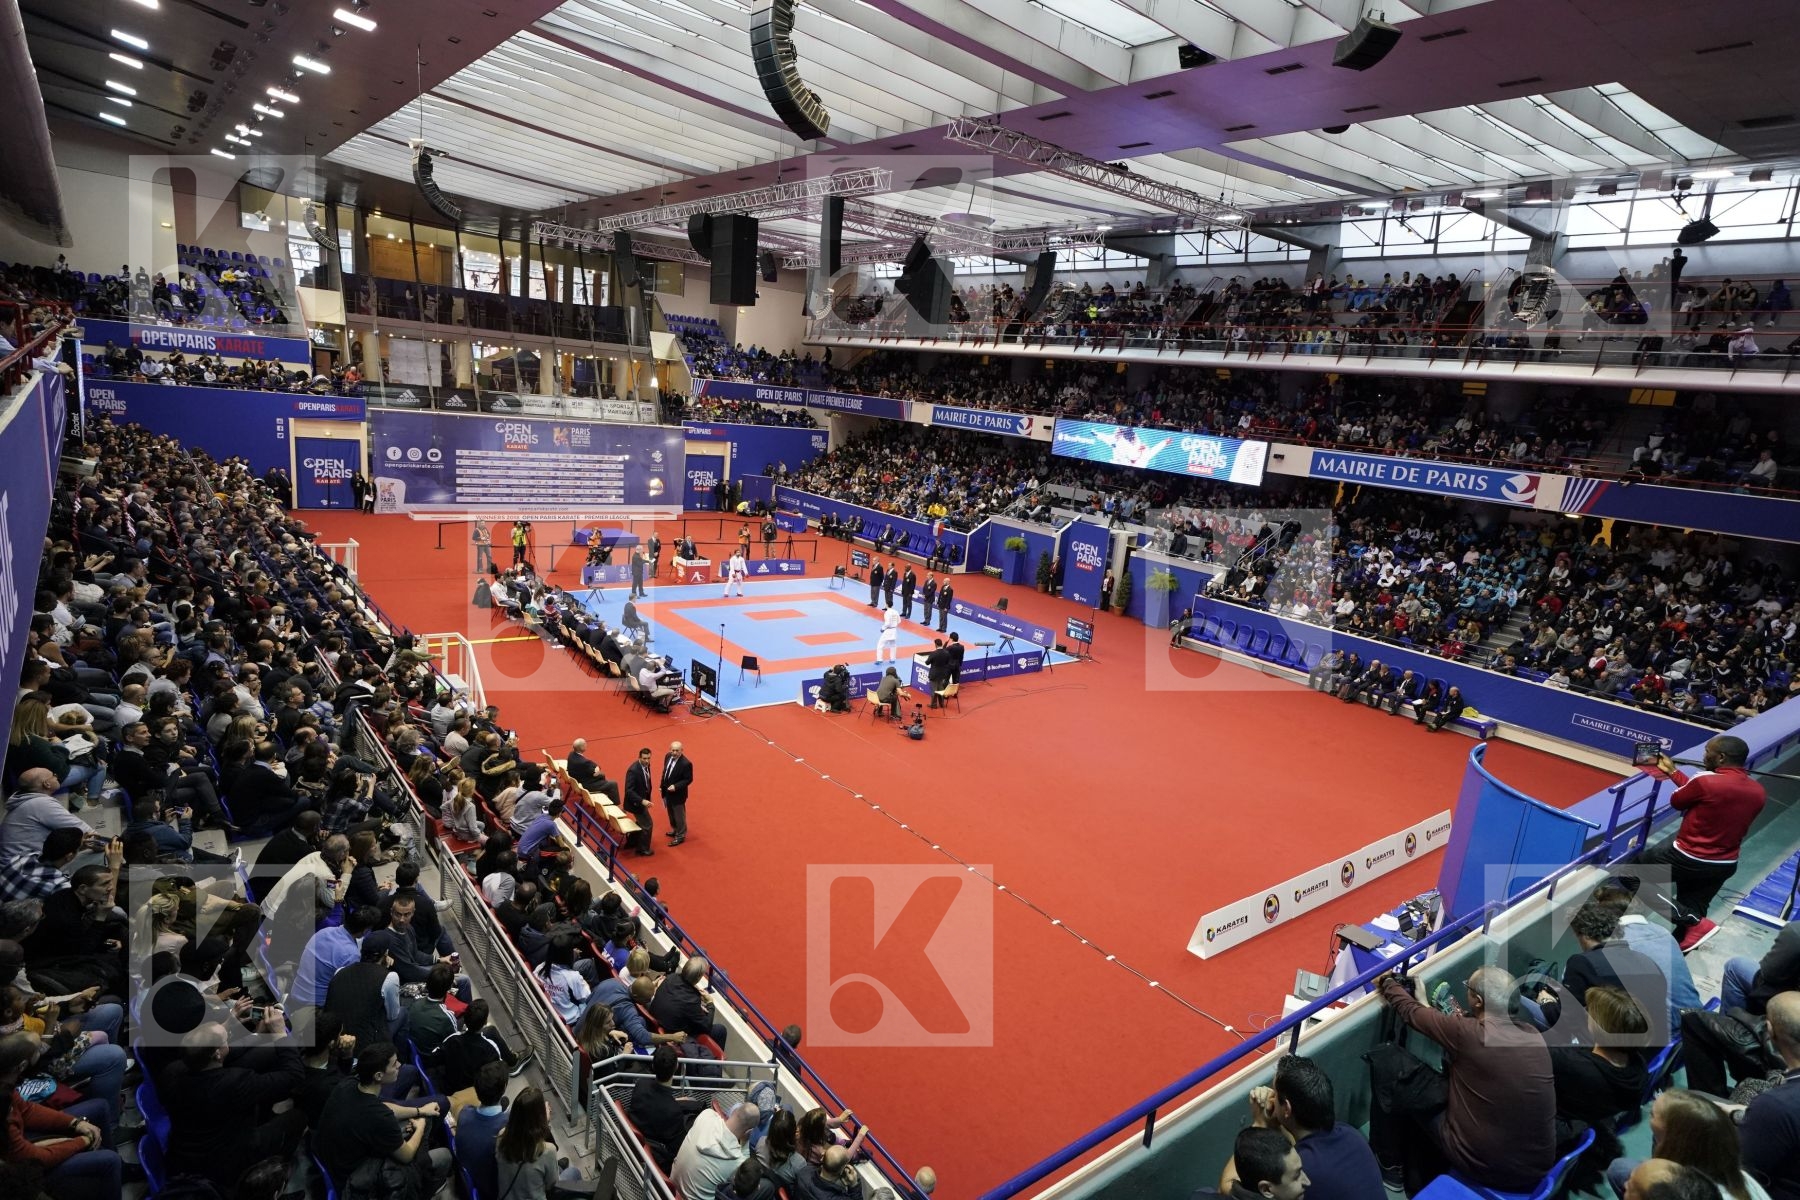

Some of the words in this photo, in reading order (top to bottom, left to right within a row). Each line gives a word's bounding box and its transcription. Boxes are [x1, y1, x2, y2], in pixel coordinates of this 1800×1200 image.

[90, 388, 114, 400] OPEN
[756, 388, 773, 400] OPEN
[774, 390, 783, 400] DE
[784, 391, 802, 402] PARIS
[99, 399, 127, 410] PARIS
[445, 400, 467, 408] adidas
[809, 393, 825, 405] KARATE
[826, 395, 845, 407] PREMIER
[845, 398, 863, 410] LEAGUE
[935, 410, 967, 424] MAIRIE
[969, 414, 980, 426] DE
[984, 416, 1012, 430] PARIS
[495, 422, 531, 434] OPEN
[571, 427, 591, 436] PARIS
[504, 433, 539, 444] PARIS
[1181, 437, 1221, 455] OPEN
[303, 457, 344, 469] OPEN
[1188, 450, 1228, 469] PARIS
[314, 468, 353, 478] PARIS
[687, 470, 713, 480] OPEN
[1317, 456, 1387, 479] MAIRIE
[1391, 465, 1420, 483] DE
[1425, 469, 1489, 491] PARIS
[693, 478, 718, 487] PARIS
[1072, 540, 1099, 556] OPEN
[1076, 551, 1102, 567] PARIS
[1580, 718, 1611, 732] MAIRIE
[1612, 726, 1625, 735] DE
[1626, 730, 1653, 743] PARIS
